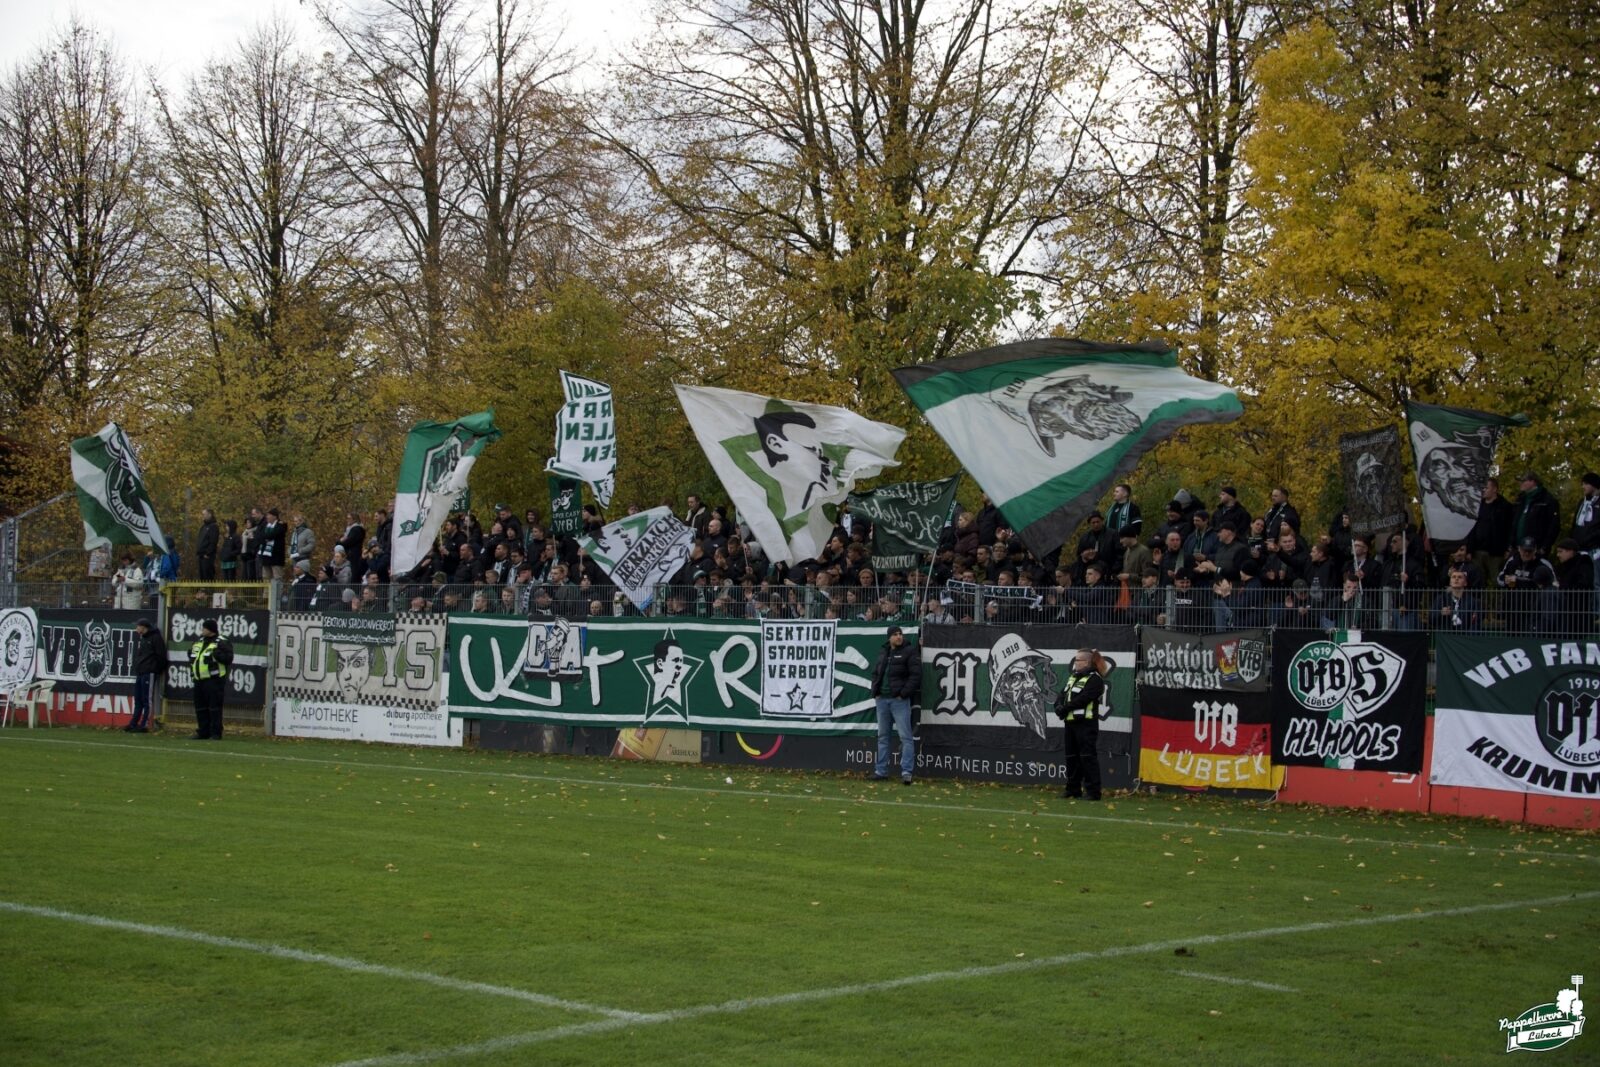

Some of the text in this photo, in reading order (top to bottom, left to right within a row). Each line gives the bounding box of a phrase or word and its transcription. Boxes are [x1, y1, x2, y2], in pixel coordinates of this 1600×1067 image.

[172, 613, 259, 643] Frotside
[765, 626, 832, 642] SEKTION
[768, 645, 828, 661] STADION
[1001, 642, 1020, 659] 1919
[1309, 646, 1332, 657] 1919
[768, 664, 828, 680] VERBOT
[1463, 648, 1533, 688] VfB
[1568, 677, 1600, 690] 1919
[1306, 695, 1337, 707] LÜBECK
[300, 706, 358, 723] APOTHEKE
[1318, 719, 1402, 761] HOOLS
[995, 760, 1023, 776] DES
[1028, 762, 1068, 779] SPOR
[1158, 743, 1266, 783] LÜBECK
